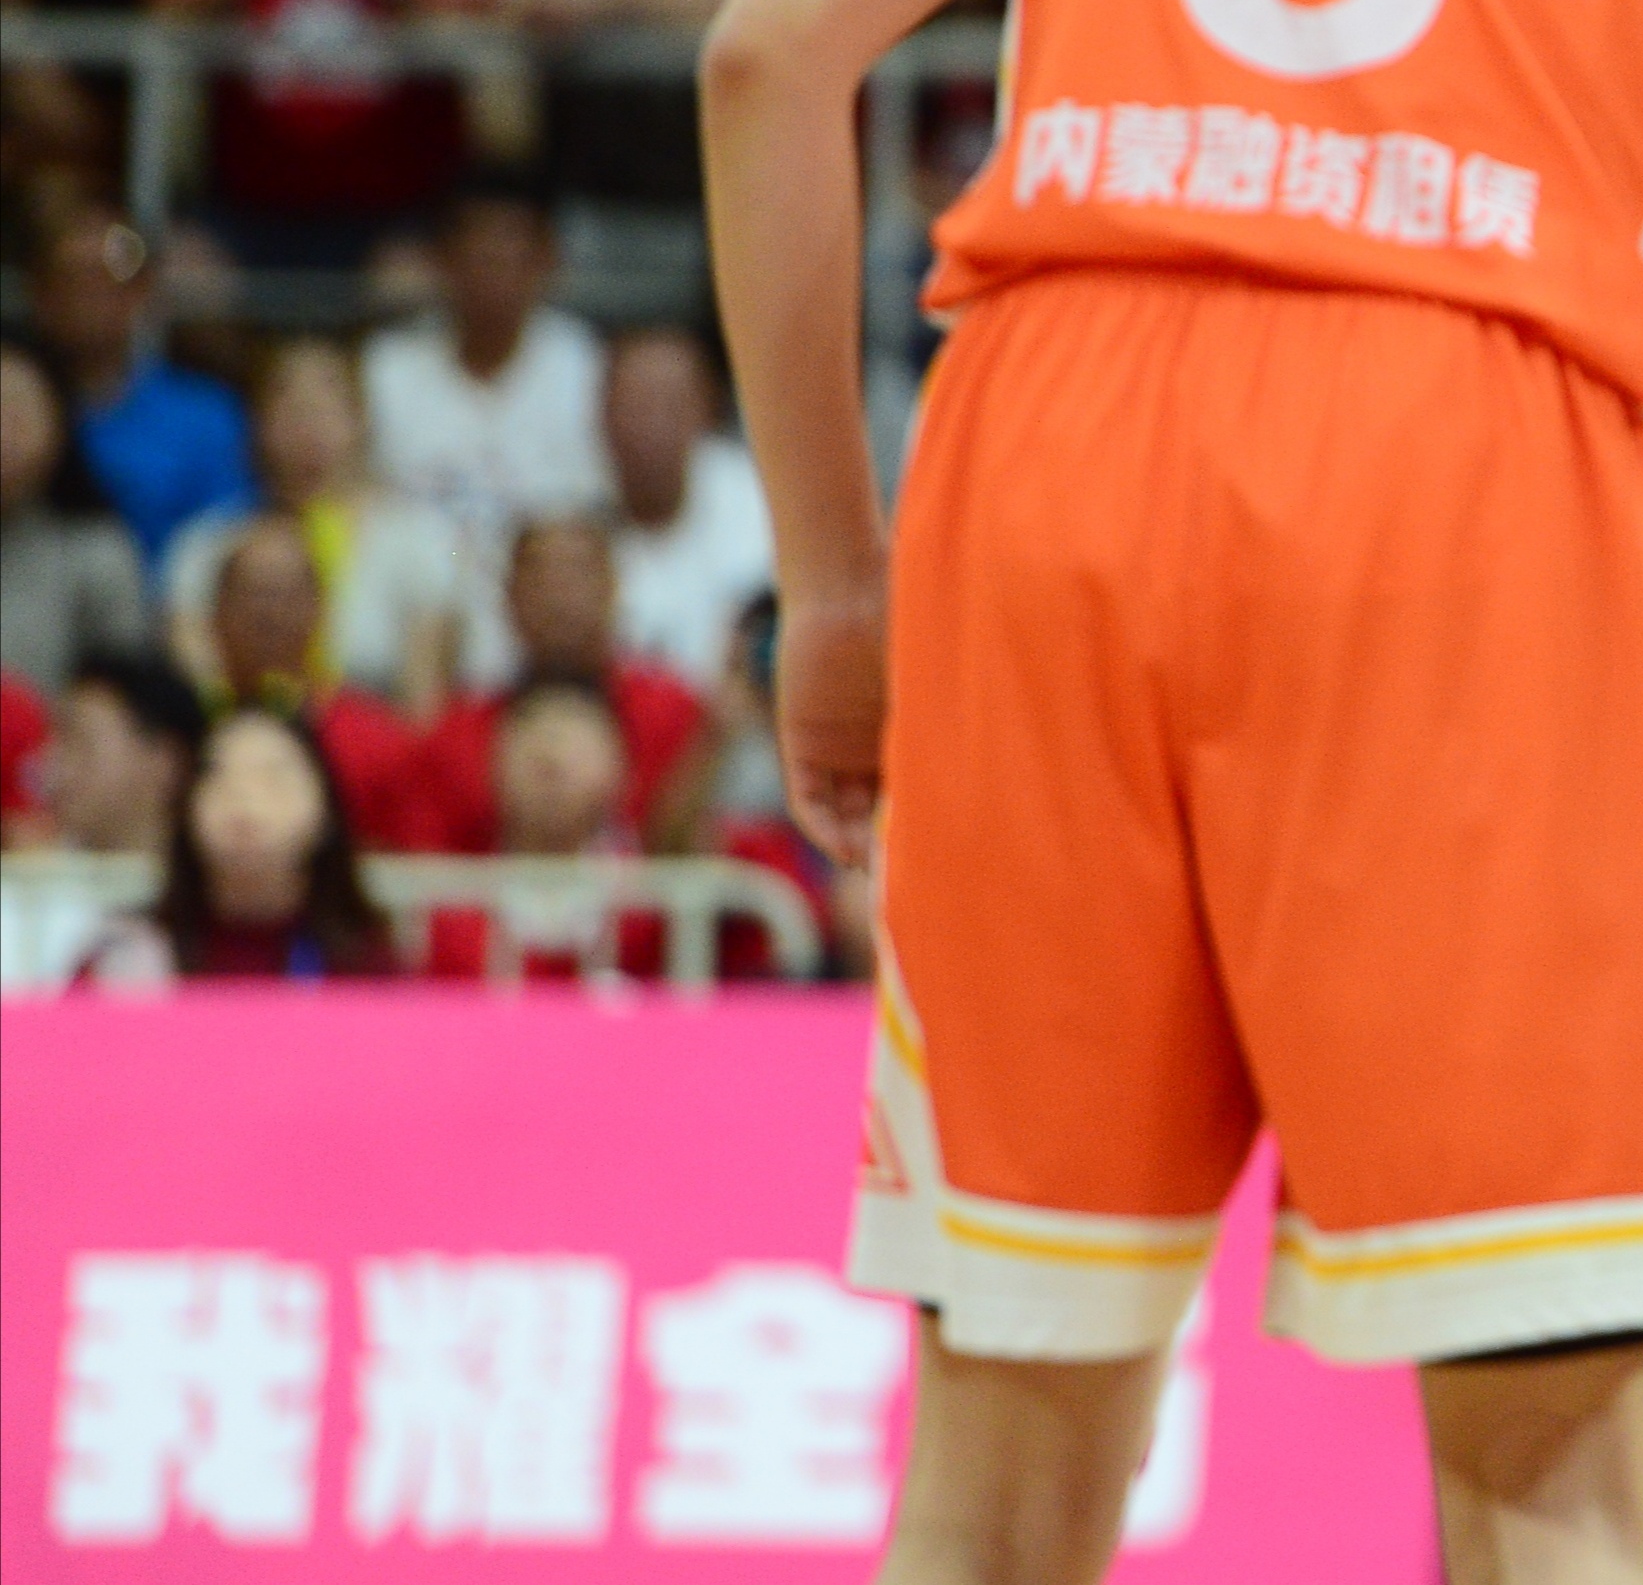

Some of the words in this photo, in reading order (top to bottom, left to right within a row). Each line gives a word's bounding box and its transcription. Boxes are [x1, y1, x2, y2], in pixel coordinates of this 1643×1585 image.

[1012, 97, 1542, 258] 内蒙融资租赁
